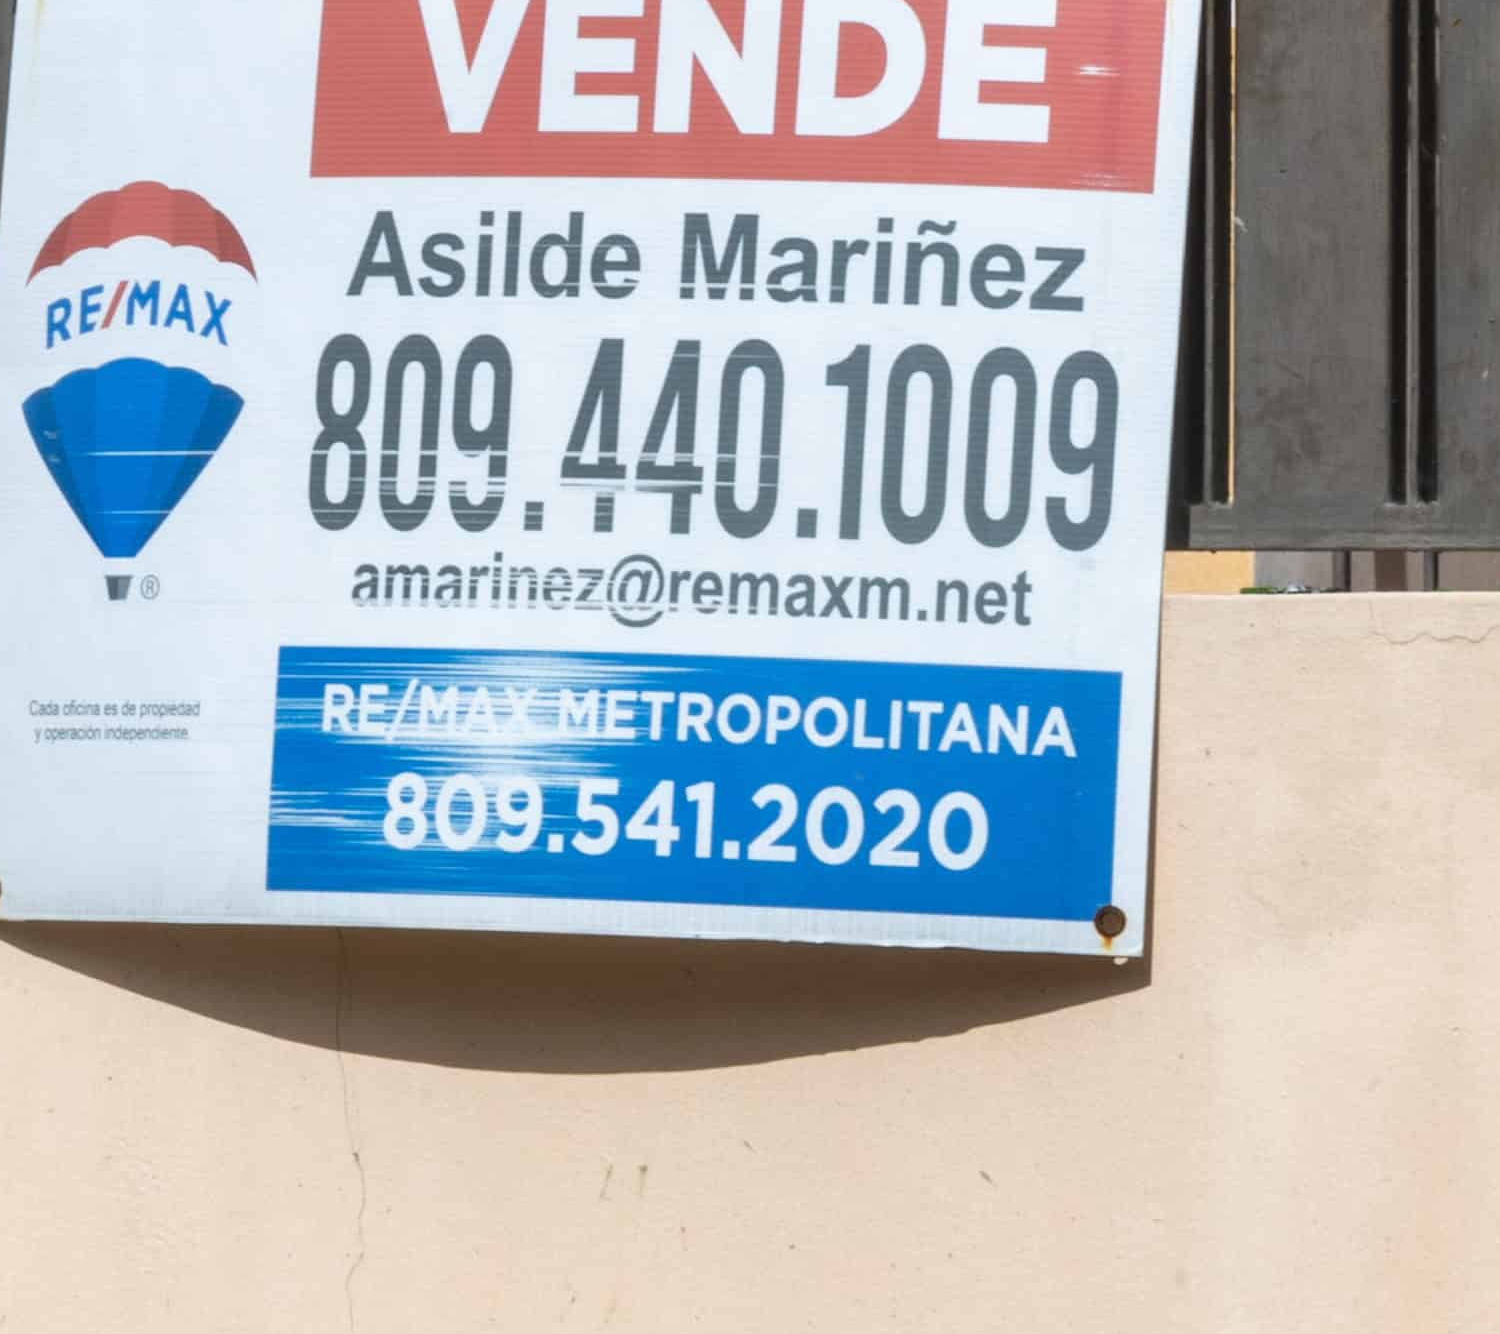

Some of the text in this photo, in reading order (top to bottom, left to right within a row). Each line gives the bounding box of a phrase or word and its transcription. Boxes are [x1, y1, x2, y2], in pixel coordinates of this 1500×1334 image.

[347, 210, 1087, 313] Asilde Mariñez
[46, 280, 232, 349] RE/MAX
[308, 333, 1119, 552] 809.440.1009
[350, 551, 1031, 629] amarinez@remaxm.net
[29, 699, 200, 720] Cada oficina es de propiedad
[34, 728, 41, 743] y
[321, 680, 1077, 759] RE/MAX METROPOLITANA
[382, 771, 990, 871] 809.541.2020
